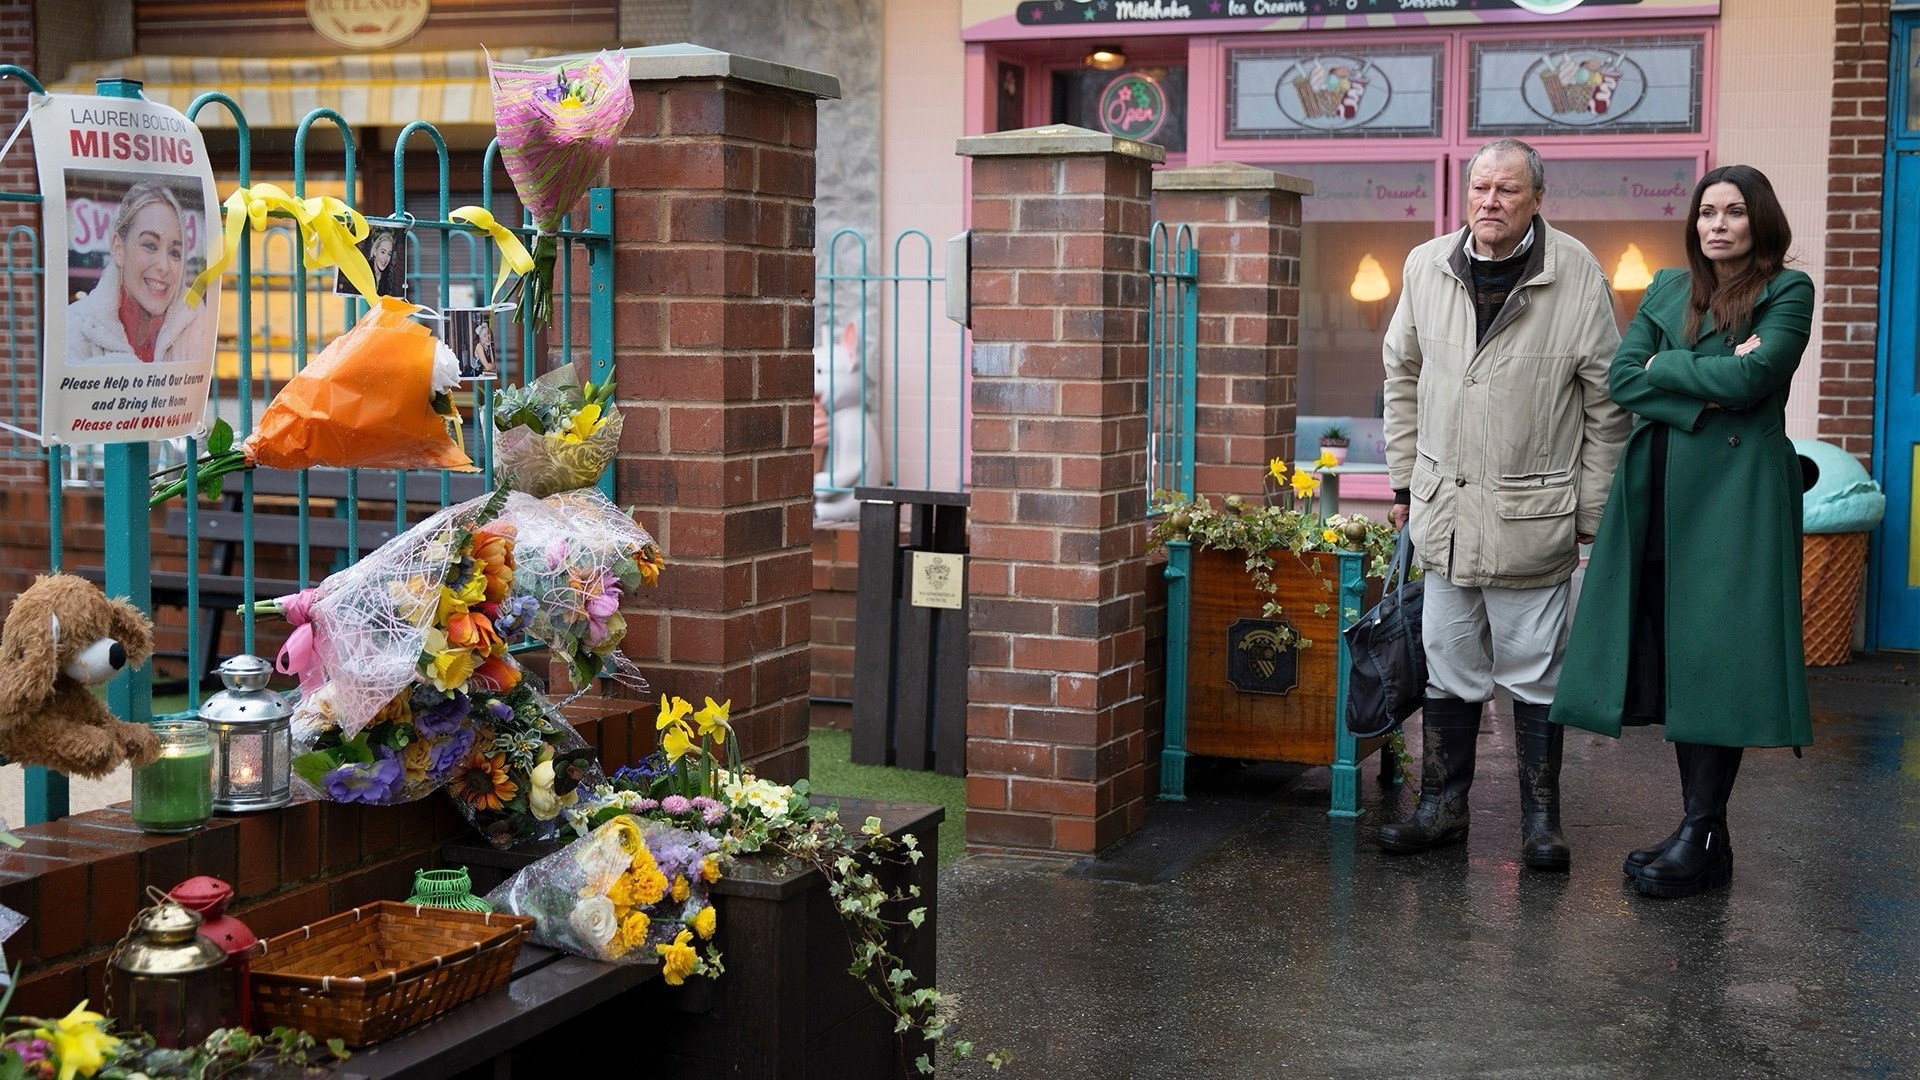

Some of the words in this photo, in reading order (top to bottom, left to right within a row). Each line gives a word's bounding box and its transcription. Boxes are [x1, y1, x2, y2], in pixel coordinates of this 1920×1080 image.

[1115, 0, 1191, 20] Milkshakes
[1228, 0, 1248, 16] Ice
[1253, 0, 1307, 15] Creams
[70, 108, 139, 128] LAUREN
[142, 113, 187, 134] BOLTON
[1108, 99, 1156, 130] Open
[69, 129, 194, 165] MISSING
[1375, 184, 1428, 200] Desserts
[1631, 182, 1688, 198] Desserts
[60, 377, 100, 390] Please
[103, 376, 129, 392] Help
[132, 377, 143, 389] to
[146, 374, 166, 388] Find
[168, 374, 183, 387] Our
[183, 373, 204, 386] Lauren
[91, 398, 117, 411] and
[117, 396, 149, 413] Bring
[151, 397, 166, 409] Her
[168, 395, 187, 408] Home
[71, 418, 113, 432] Please
[115, 416, 139, 430] call
